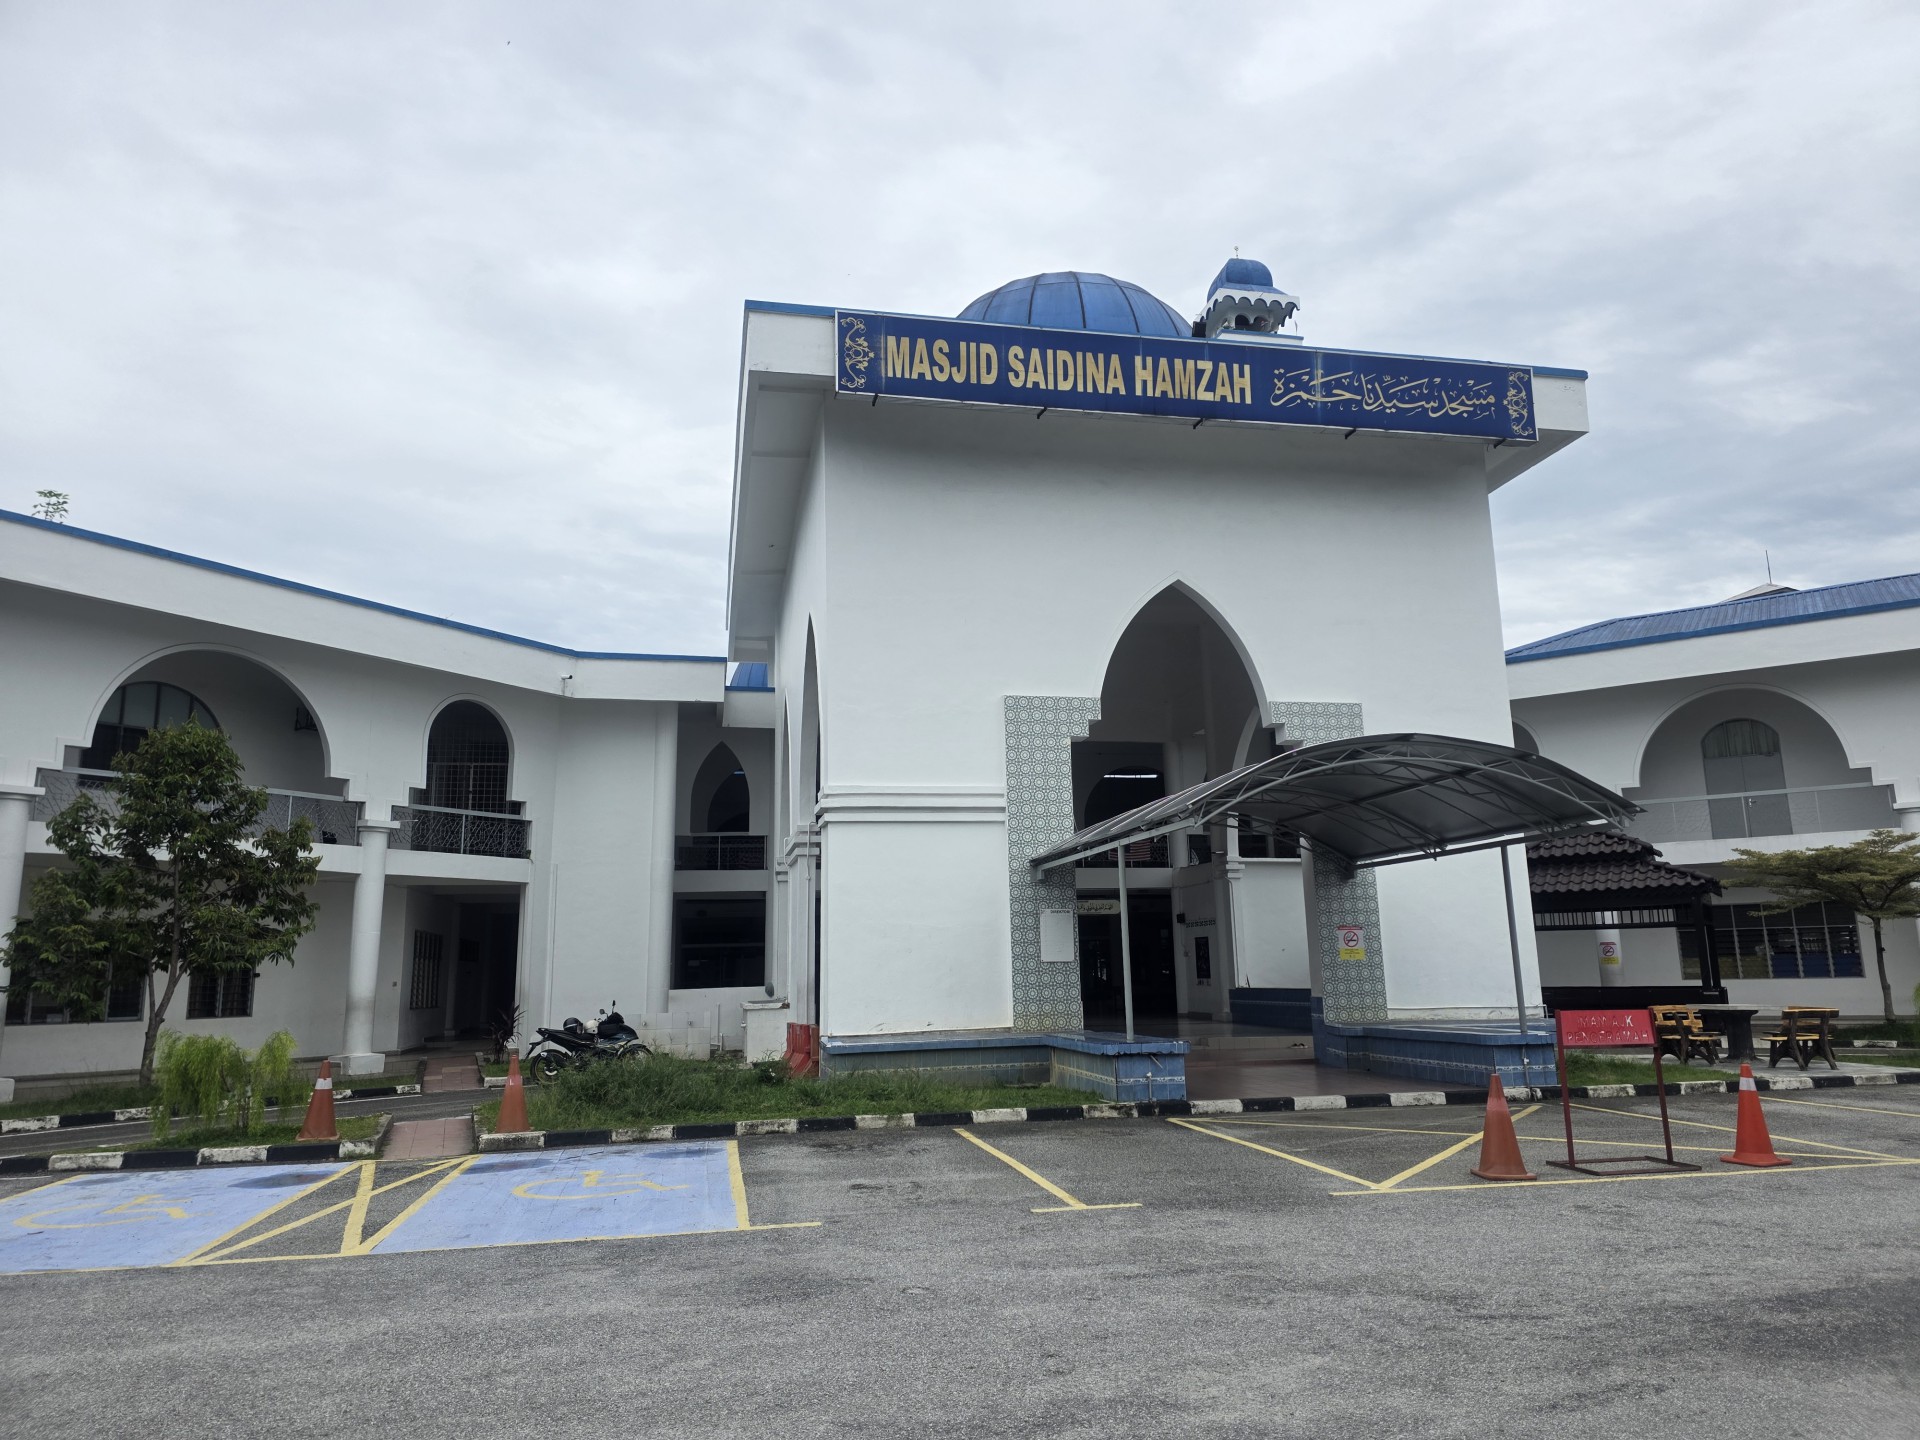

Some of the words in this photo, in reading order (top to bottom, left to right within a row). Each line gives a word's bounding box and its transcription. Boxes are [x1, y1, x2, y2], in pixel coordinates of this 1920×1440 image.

[887, 335, 999, 385] MASJID
[1008, 345, 1126, 395] SAIDINA
[1134, 355, 1252, 404] HAMZAH
